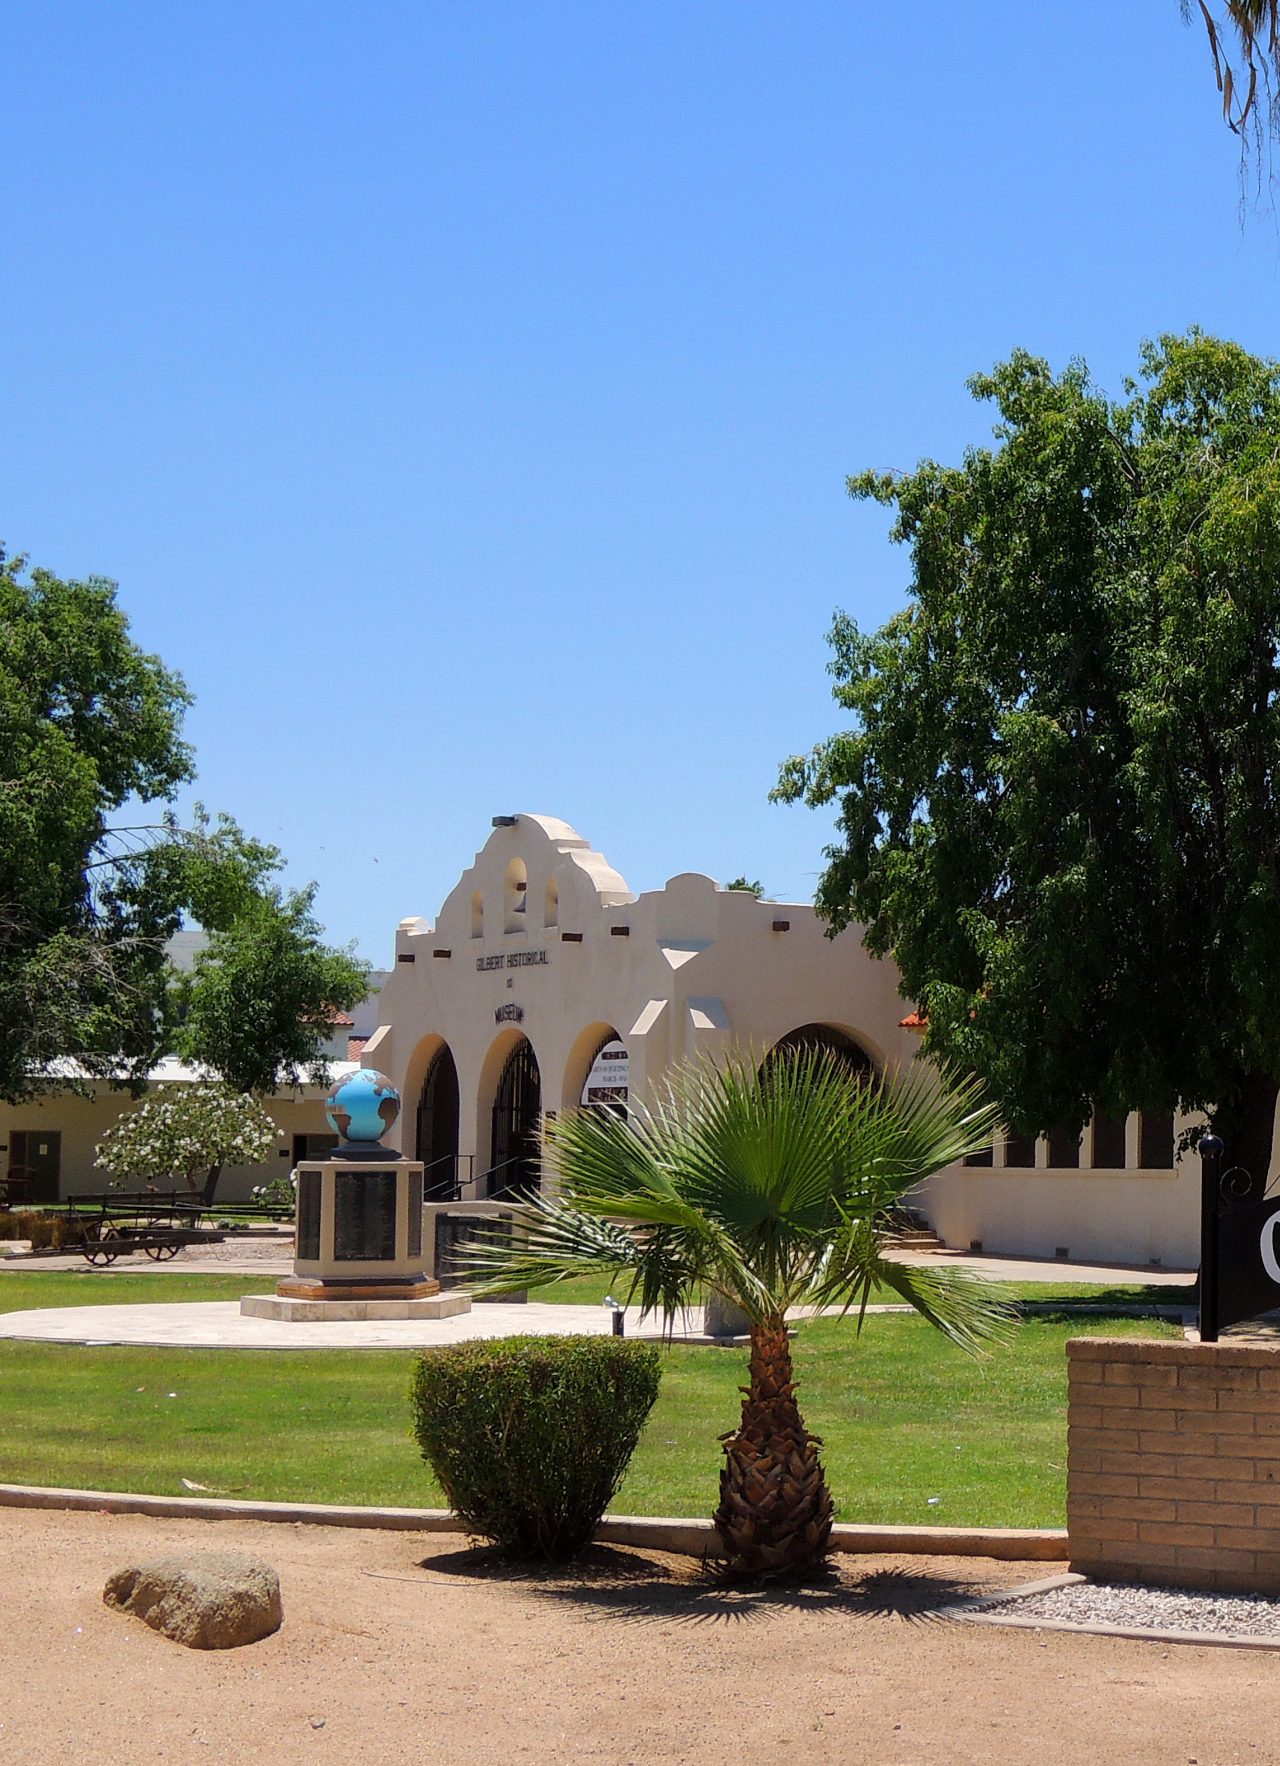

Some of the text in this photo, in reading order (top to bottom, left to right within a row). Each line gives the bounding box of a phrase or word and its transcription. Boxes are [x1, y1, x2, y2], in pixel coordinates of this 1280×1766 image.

[476, 950, 549, 972] GILBERT HISTORICAL
[495, 1003, 524, 1026] MUSEUM
